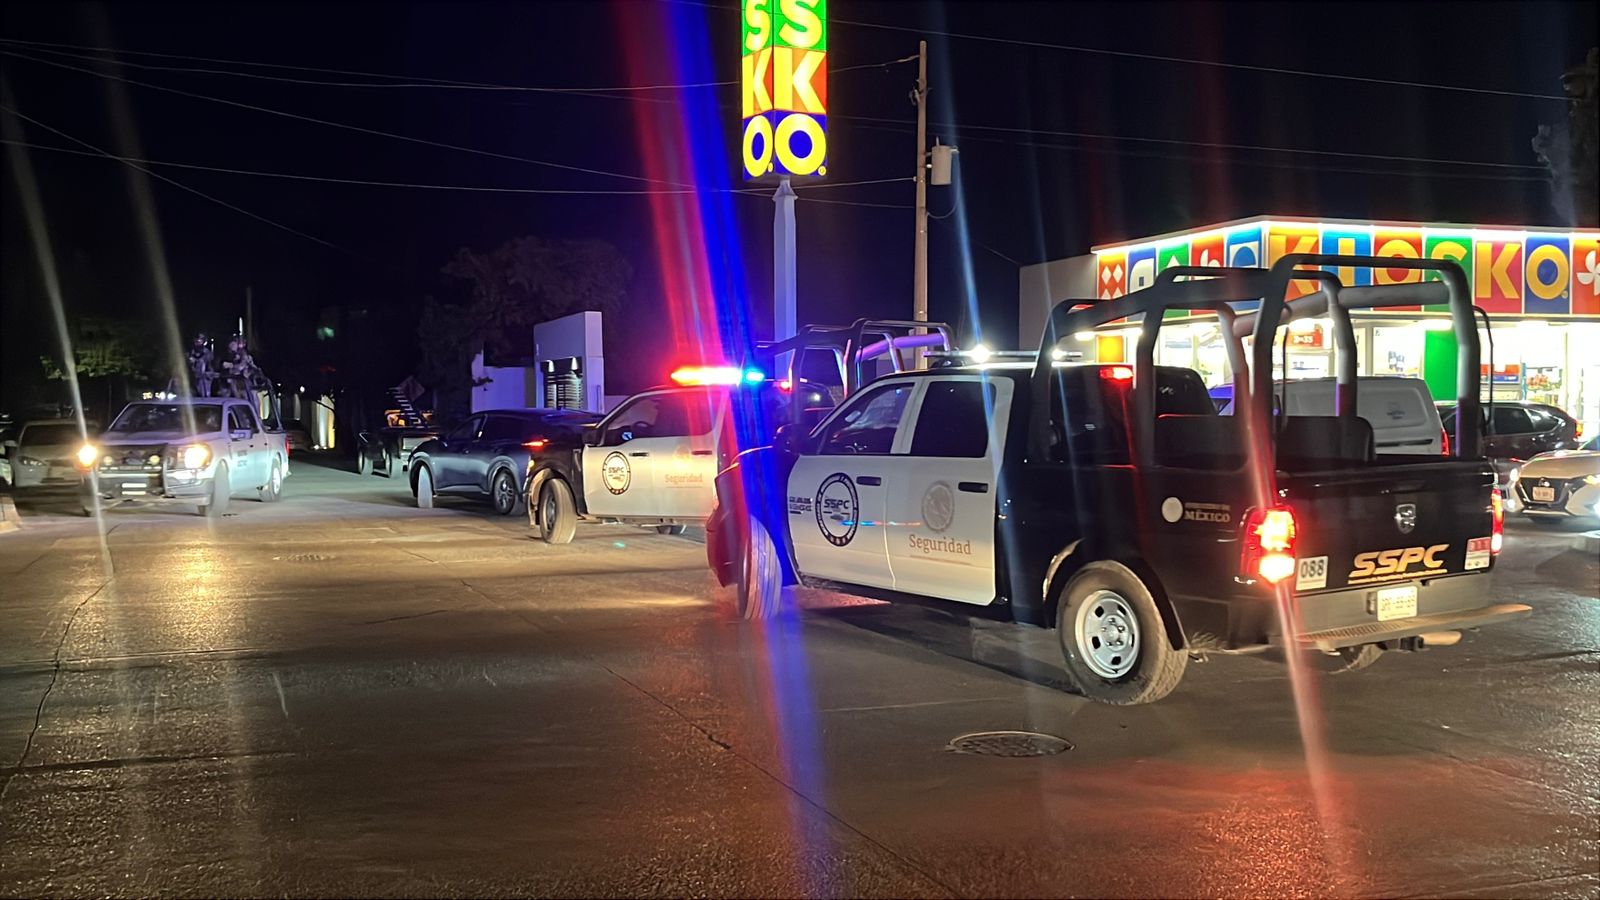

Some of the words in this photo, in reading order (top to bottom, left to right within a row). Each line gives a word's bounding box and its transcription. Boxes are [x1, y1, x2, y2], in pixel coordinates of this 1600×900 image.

[665, 473, 703, 485] Seguridad
[823, 498, 850, 510] SSPC
[1184, 509, 1231, 522] MÉXICO
[908, 534, 972, 555] Seguridad
[1348, 543, 1450, 577] SSPC
[1300, 559, 1325, 578] 088
